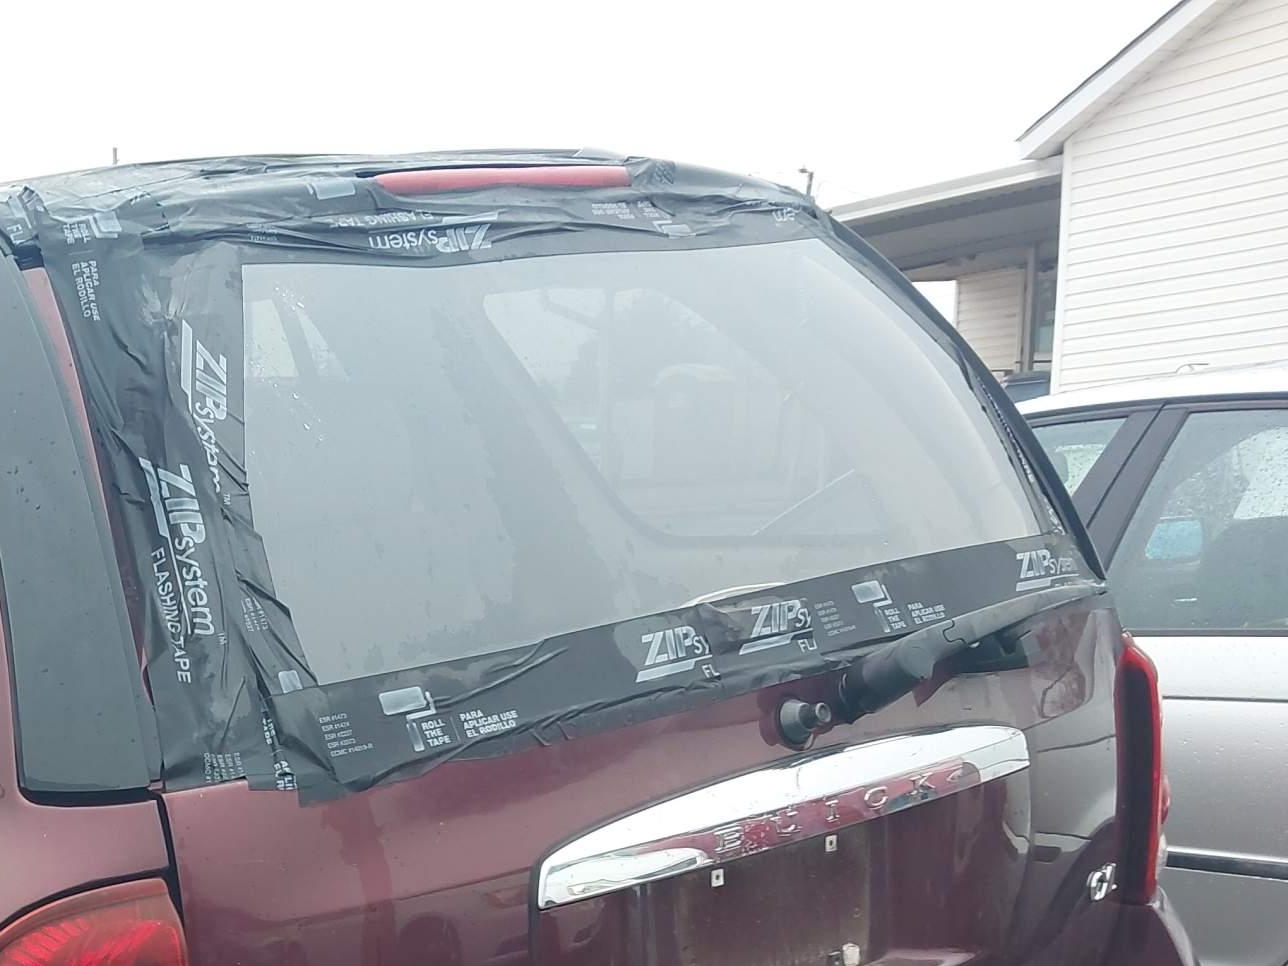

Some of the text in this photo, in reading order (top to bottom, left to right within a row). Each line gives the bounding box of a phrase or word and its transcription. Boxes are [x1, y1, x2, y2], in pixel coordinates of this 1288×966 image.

[436, 224, 492, 253] ZIP
[89, 260, 100, 286] PARA
[71, 264, 91, 318] EL RODILLO
[80, 262, 101, 321] APLICAR USE
[196, 340, 227, 420] ZIP
[157, 463, 206, 544] ZIP
[1016, 549, 1052, 578] ZIP
[151, 546, 192, 684] FLASHING TAPE
[751, 599, 802, 638] ZIP
[641, 625, 697, 666] ZIP
[421, 719, 446, 731] ROLL
[459, 709, 484, 722] PARA
[463, 710, 519, 731] APLICAR USE
[466, 719, 517, 738] EL RODILLO
[424, 729, 444, 739] THE
[427, 736, 452, 747] TAPE
